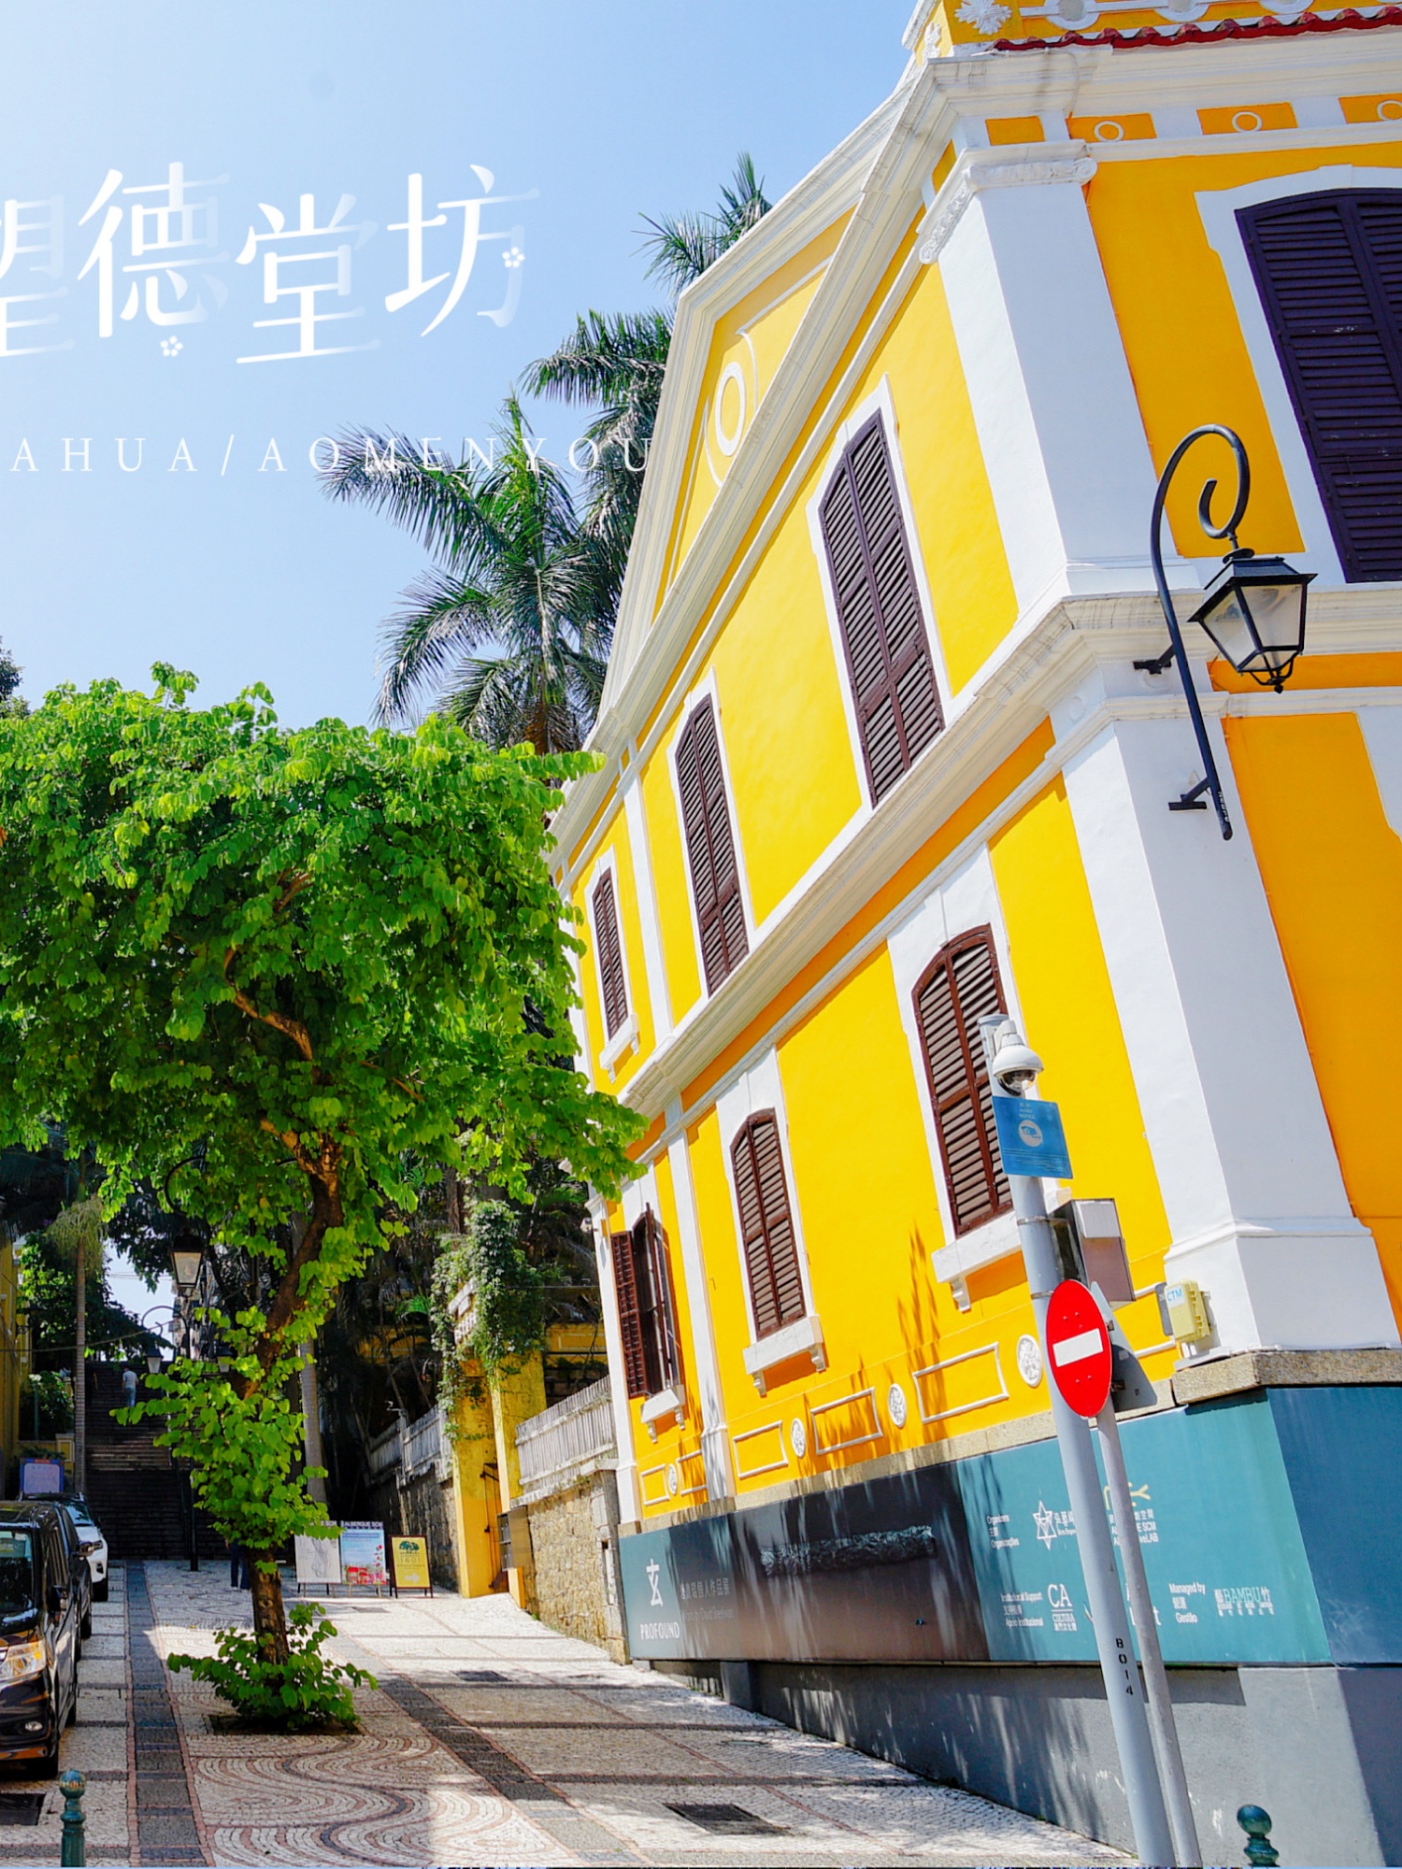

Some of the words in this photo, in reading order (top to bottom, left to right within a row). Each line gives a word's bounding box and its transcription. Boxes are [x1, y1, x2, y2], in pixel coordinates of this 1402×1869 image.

[1167, 1288, 1182, 1301] CTM
[1048, 1584, 1073, 1607] CA
[640, 1622, 680, 1640] PROFOUND
